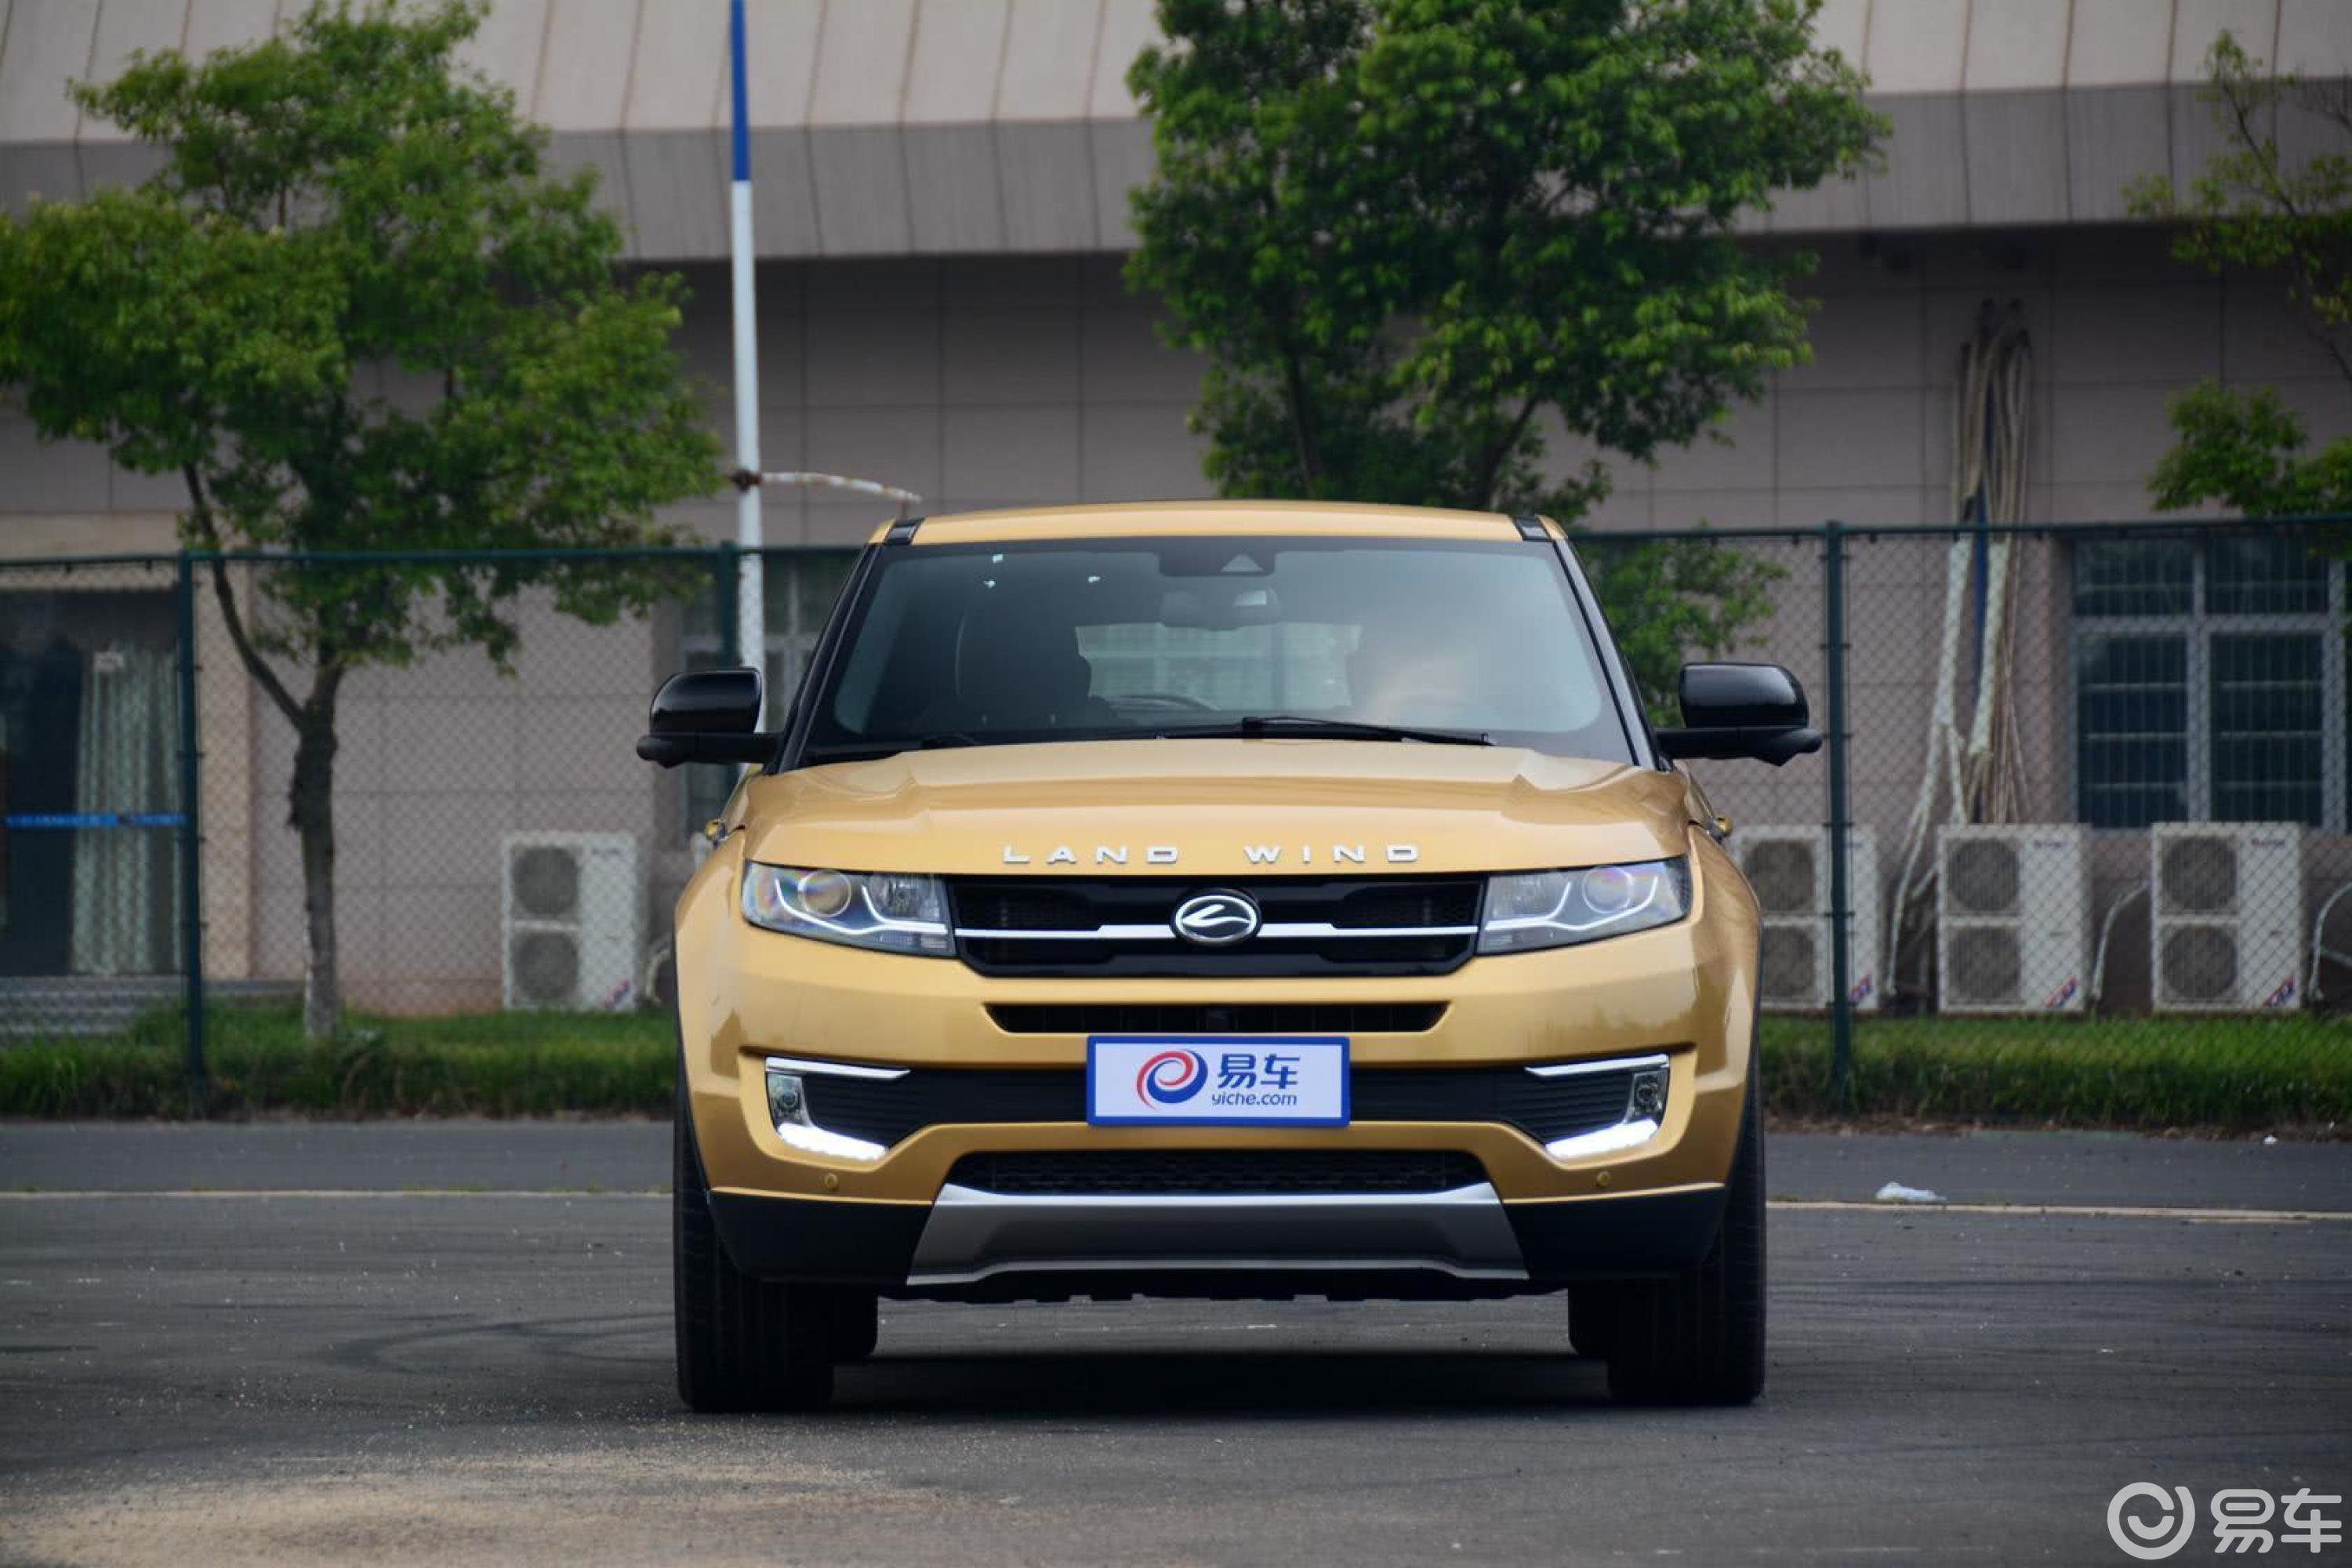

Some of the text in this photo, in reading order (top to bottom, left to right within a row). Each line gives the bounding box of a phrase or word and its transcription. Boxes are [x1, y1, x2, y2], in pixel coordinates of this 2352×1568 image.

[1003, 844, 1419, 864] LAND WIND
[1217, 1053, 1300, 1089] 易车
[1211, 1091, 1298, 1106] yiche.com
